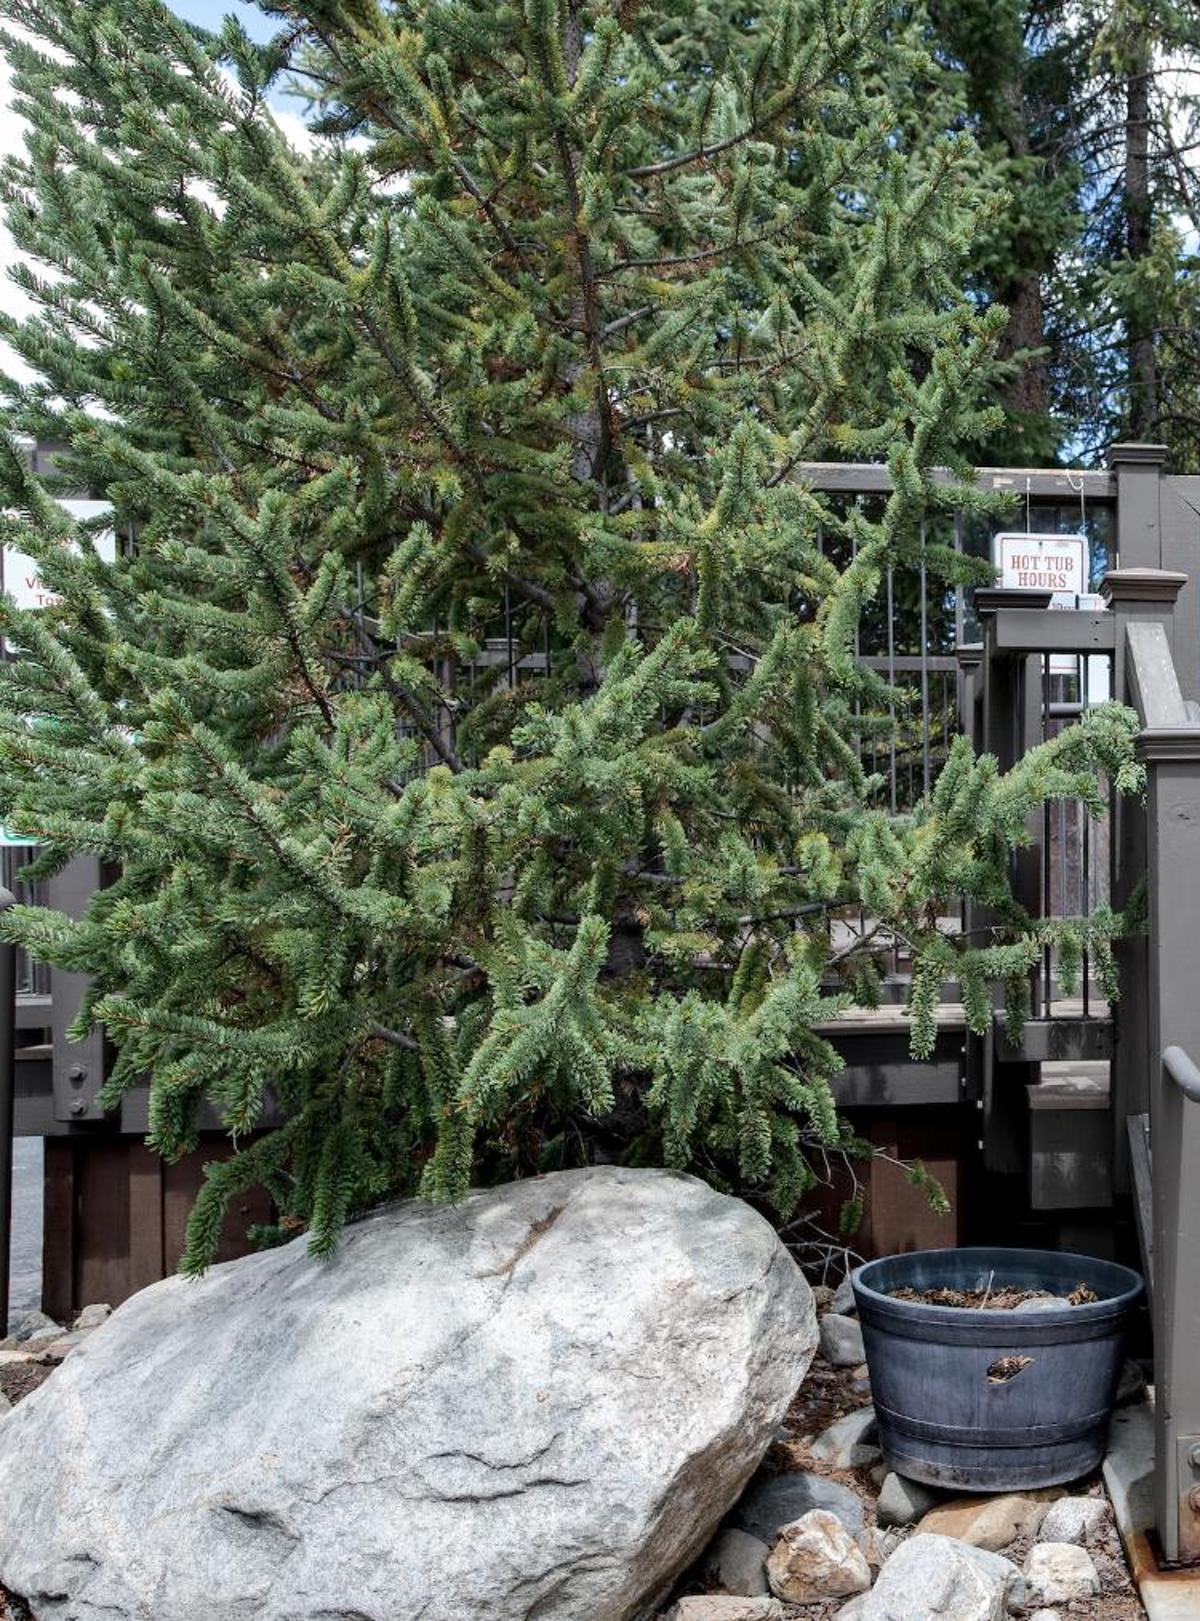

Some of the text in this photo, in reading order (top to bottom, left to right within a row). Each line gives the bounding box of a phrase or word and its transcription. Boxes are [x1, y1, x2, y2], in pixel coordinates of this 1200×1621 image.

[1010, 555, 1074, 571] HOT TUB
[1018, 572, 1067, 588] HOURS
